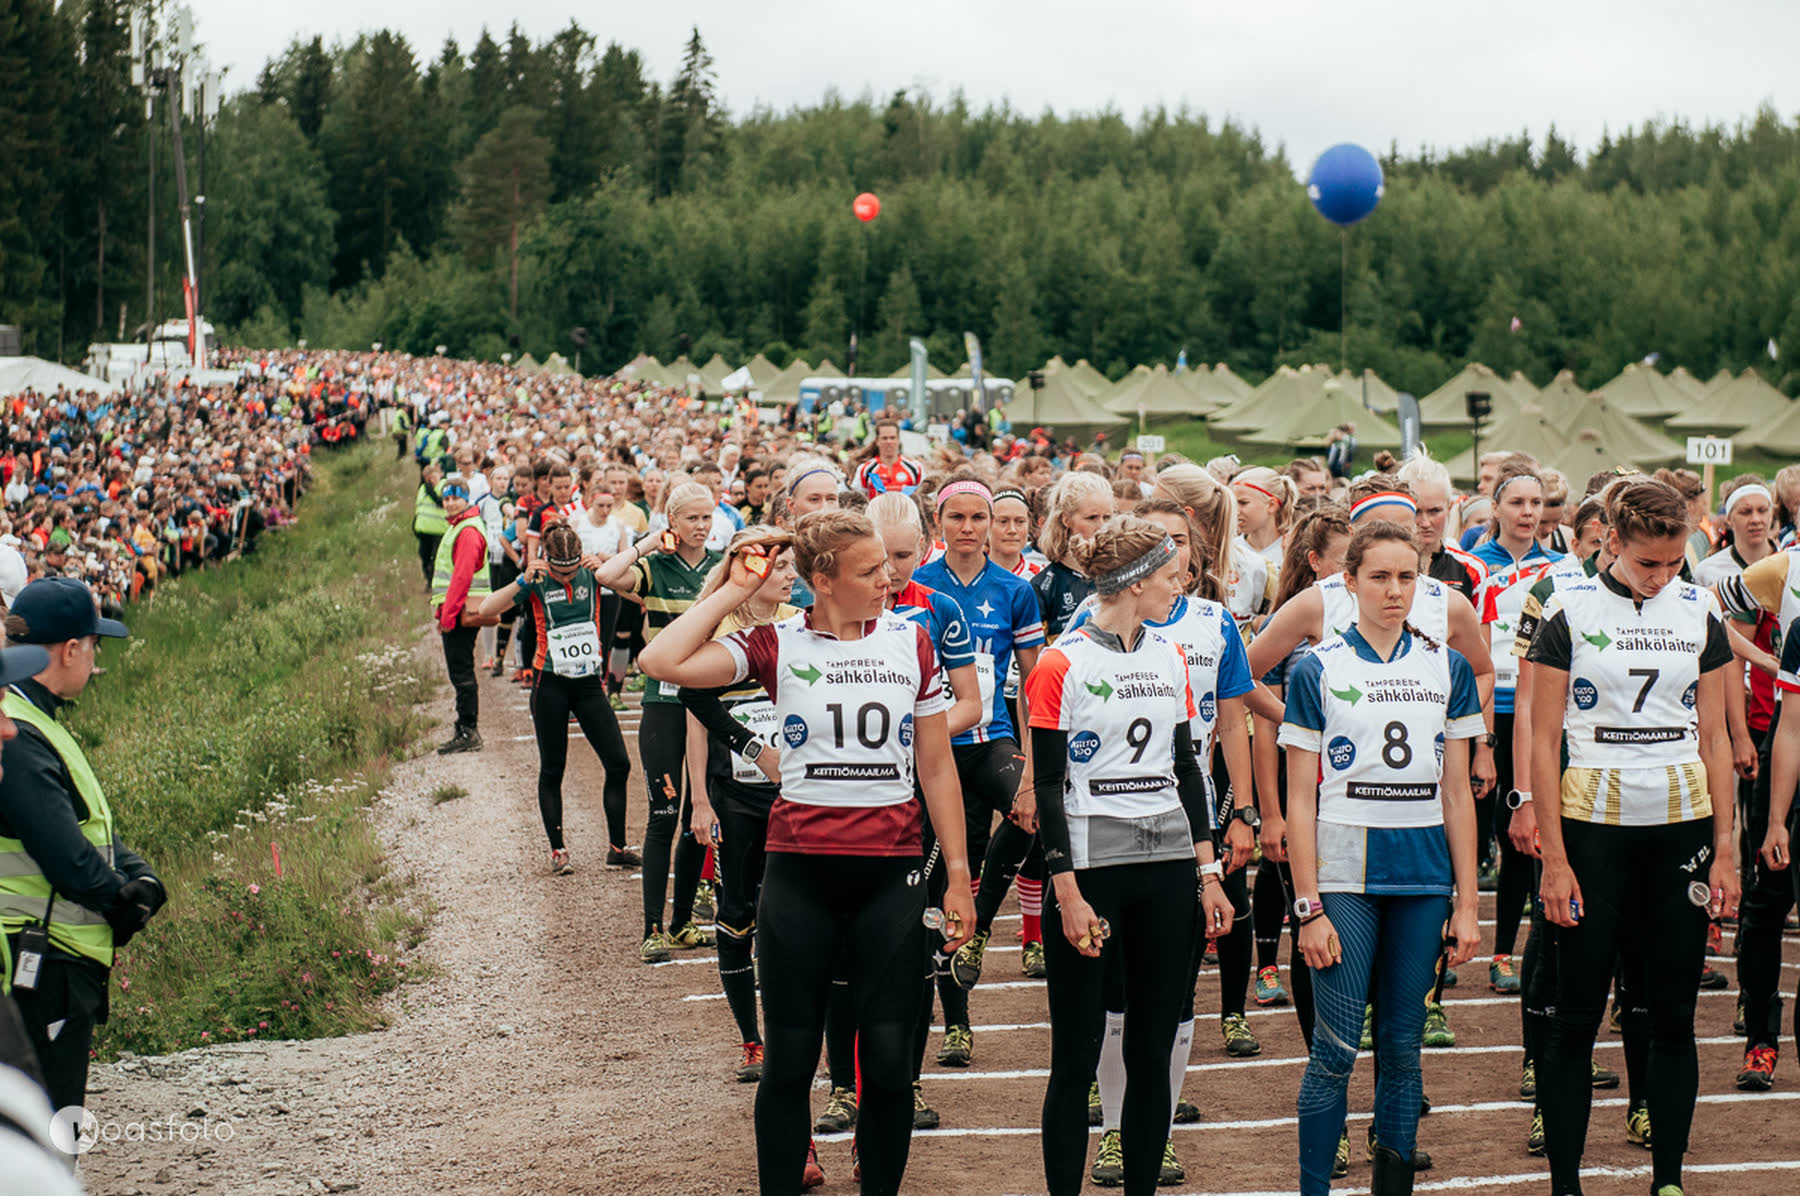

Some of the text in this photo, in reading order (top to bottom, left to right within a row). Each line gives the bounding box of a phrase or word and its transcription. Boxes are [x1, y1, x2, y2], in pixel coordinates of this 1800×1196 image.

[1697, 442, 1726, 459] 101
[1116, 562, 1150, 583] TRIMTEX
[1616, 627, 1674, 636] TAMPEREEN
[560, 642, 592, 659] 100
[825, 659, 885, 668] TAMPEREEN
[826, 669, 912, 686] sähkölaitos
[1365, 679, 1421, 687] TAMPEREEN
[1367, 687, 1446, 705] sähkölaitos
[1628, 668, 1660, 714] 7
[826, 701, 891, 750] 10
[1127, 717, 1153, 764] 9
[1382, 720, 1413, 770] 8
[812, 766, 895, 777] KEITTIÖMAAILMA
[1355, 785, 1432, 797] KEITTIÖMAAILMA
